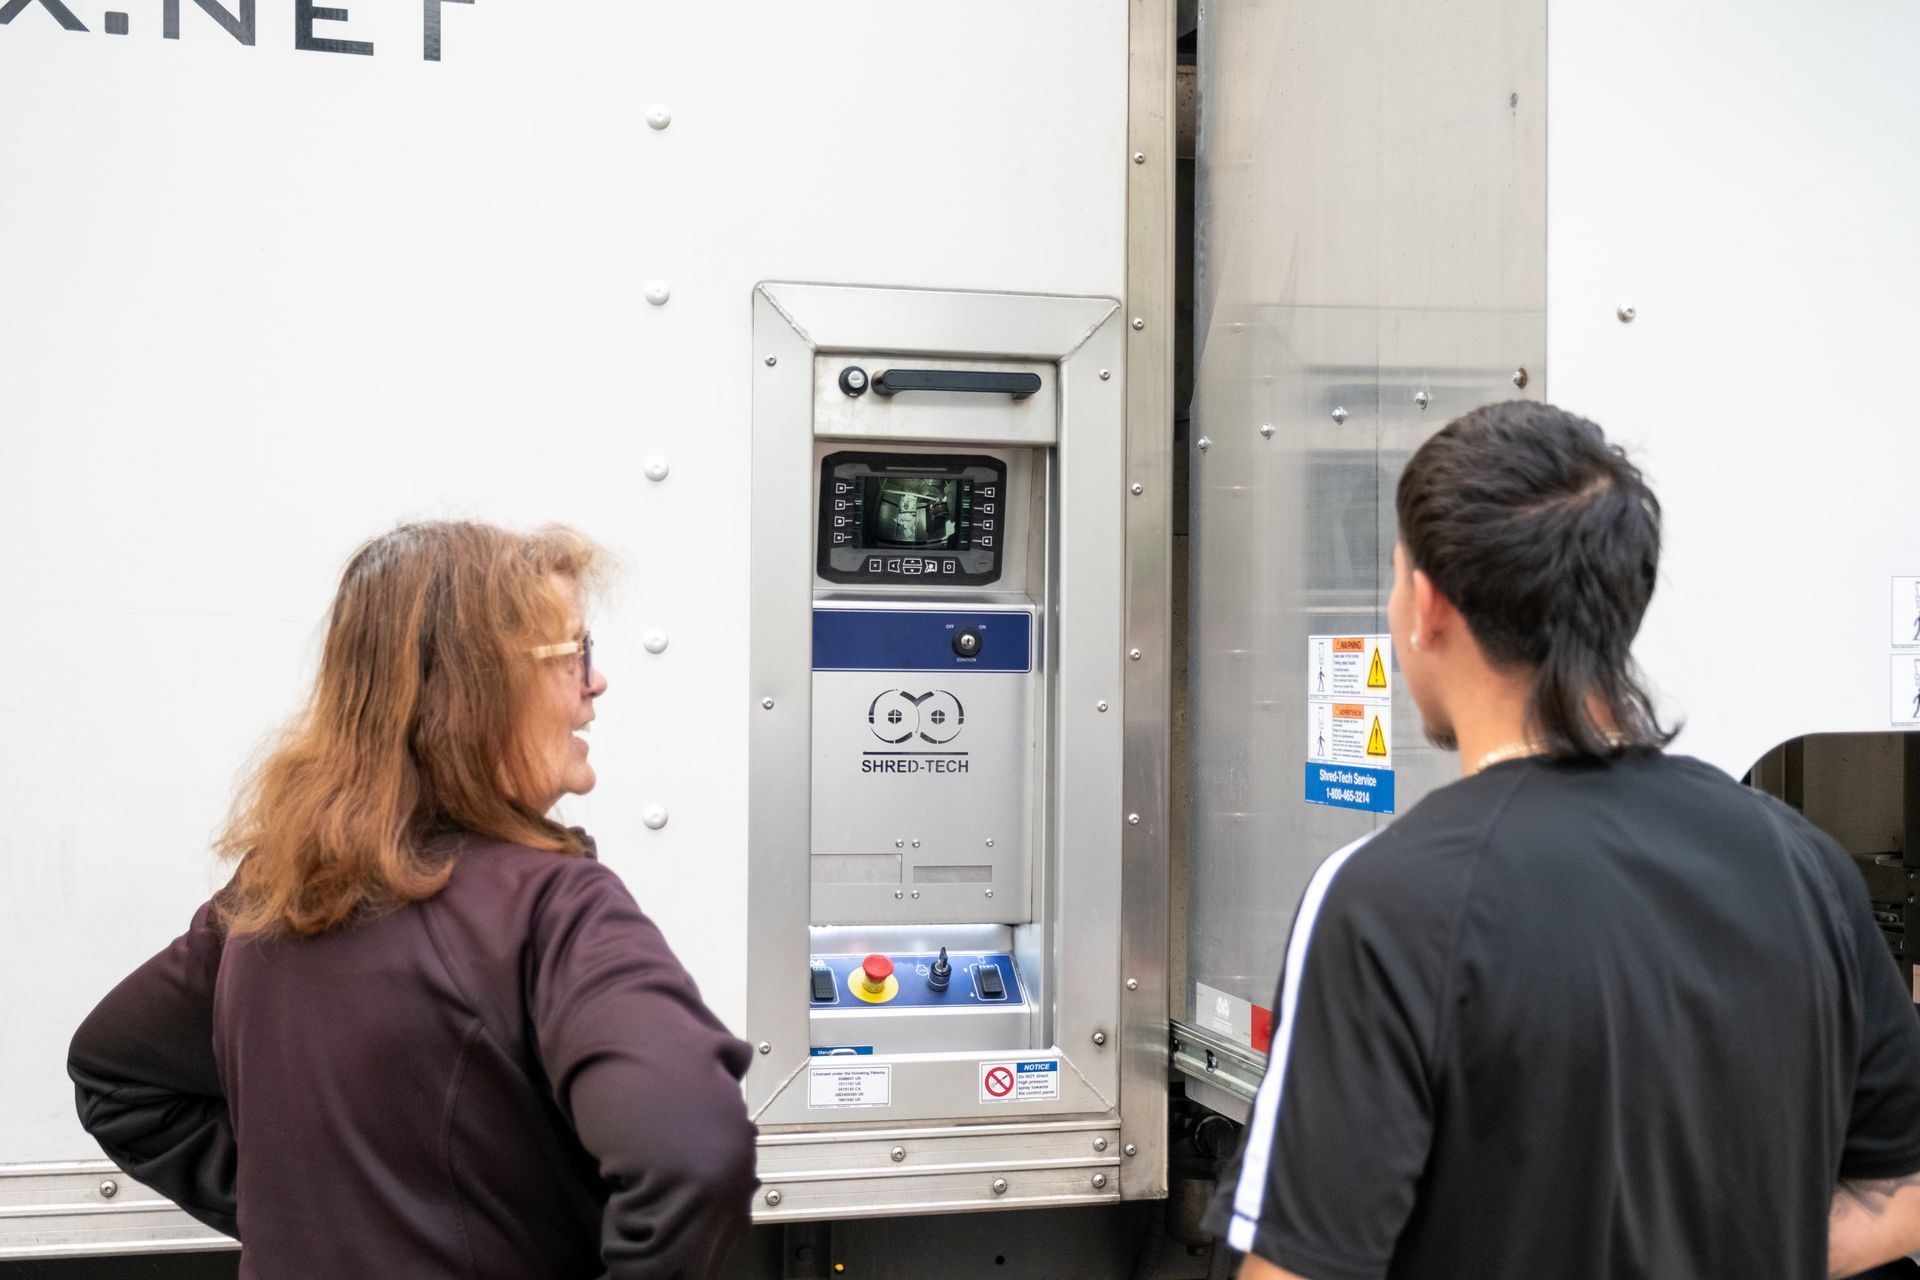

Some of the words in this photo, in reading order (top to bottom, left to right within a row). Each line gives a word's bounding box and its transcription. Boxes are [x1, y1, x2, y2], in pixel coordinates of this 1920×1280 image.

[1340, 640, 1361, 650] WARNING
[861, 759, 969, 773] SHRED-TECH
[1319, 768, 1353, 784] Shred-Tech
[1353, 773, 1377, 787] Service
[1326, 787, 1370, 804] 1-800-465-3214
[1023, 1063, 1051, 1071] NOTICE
